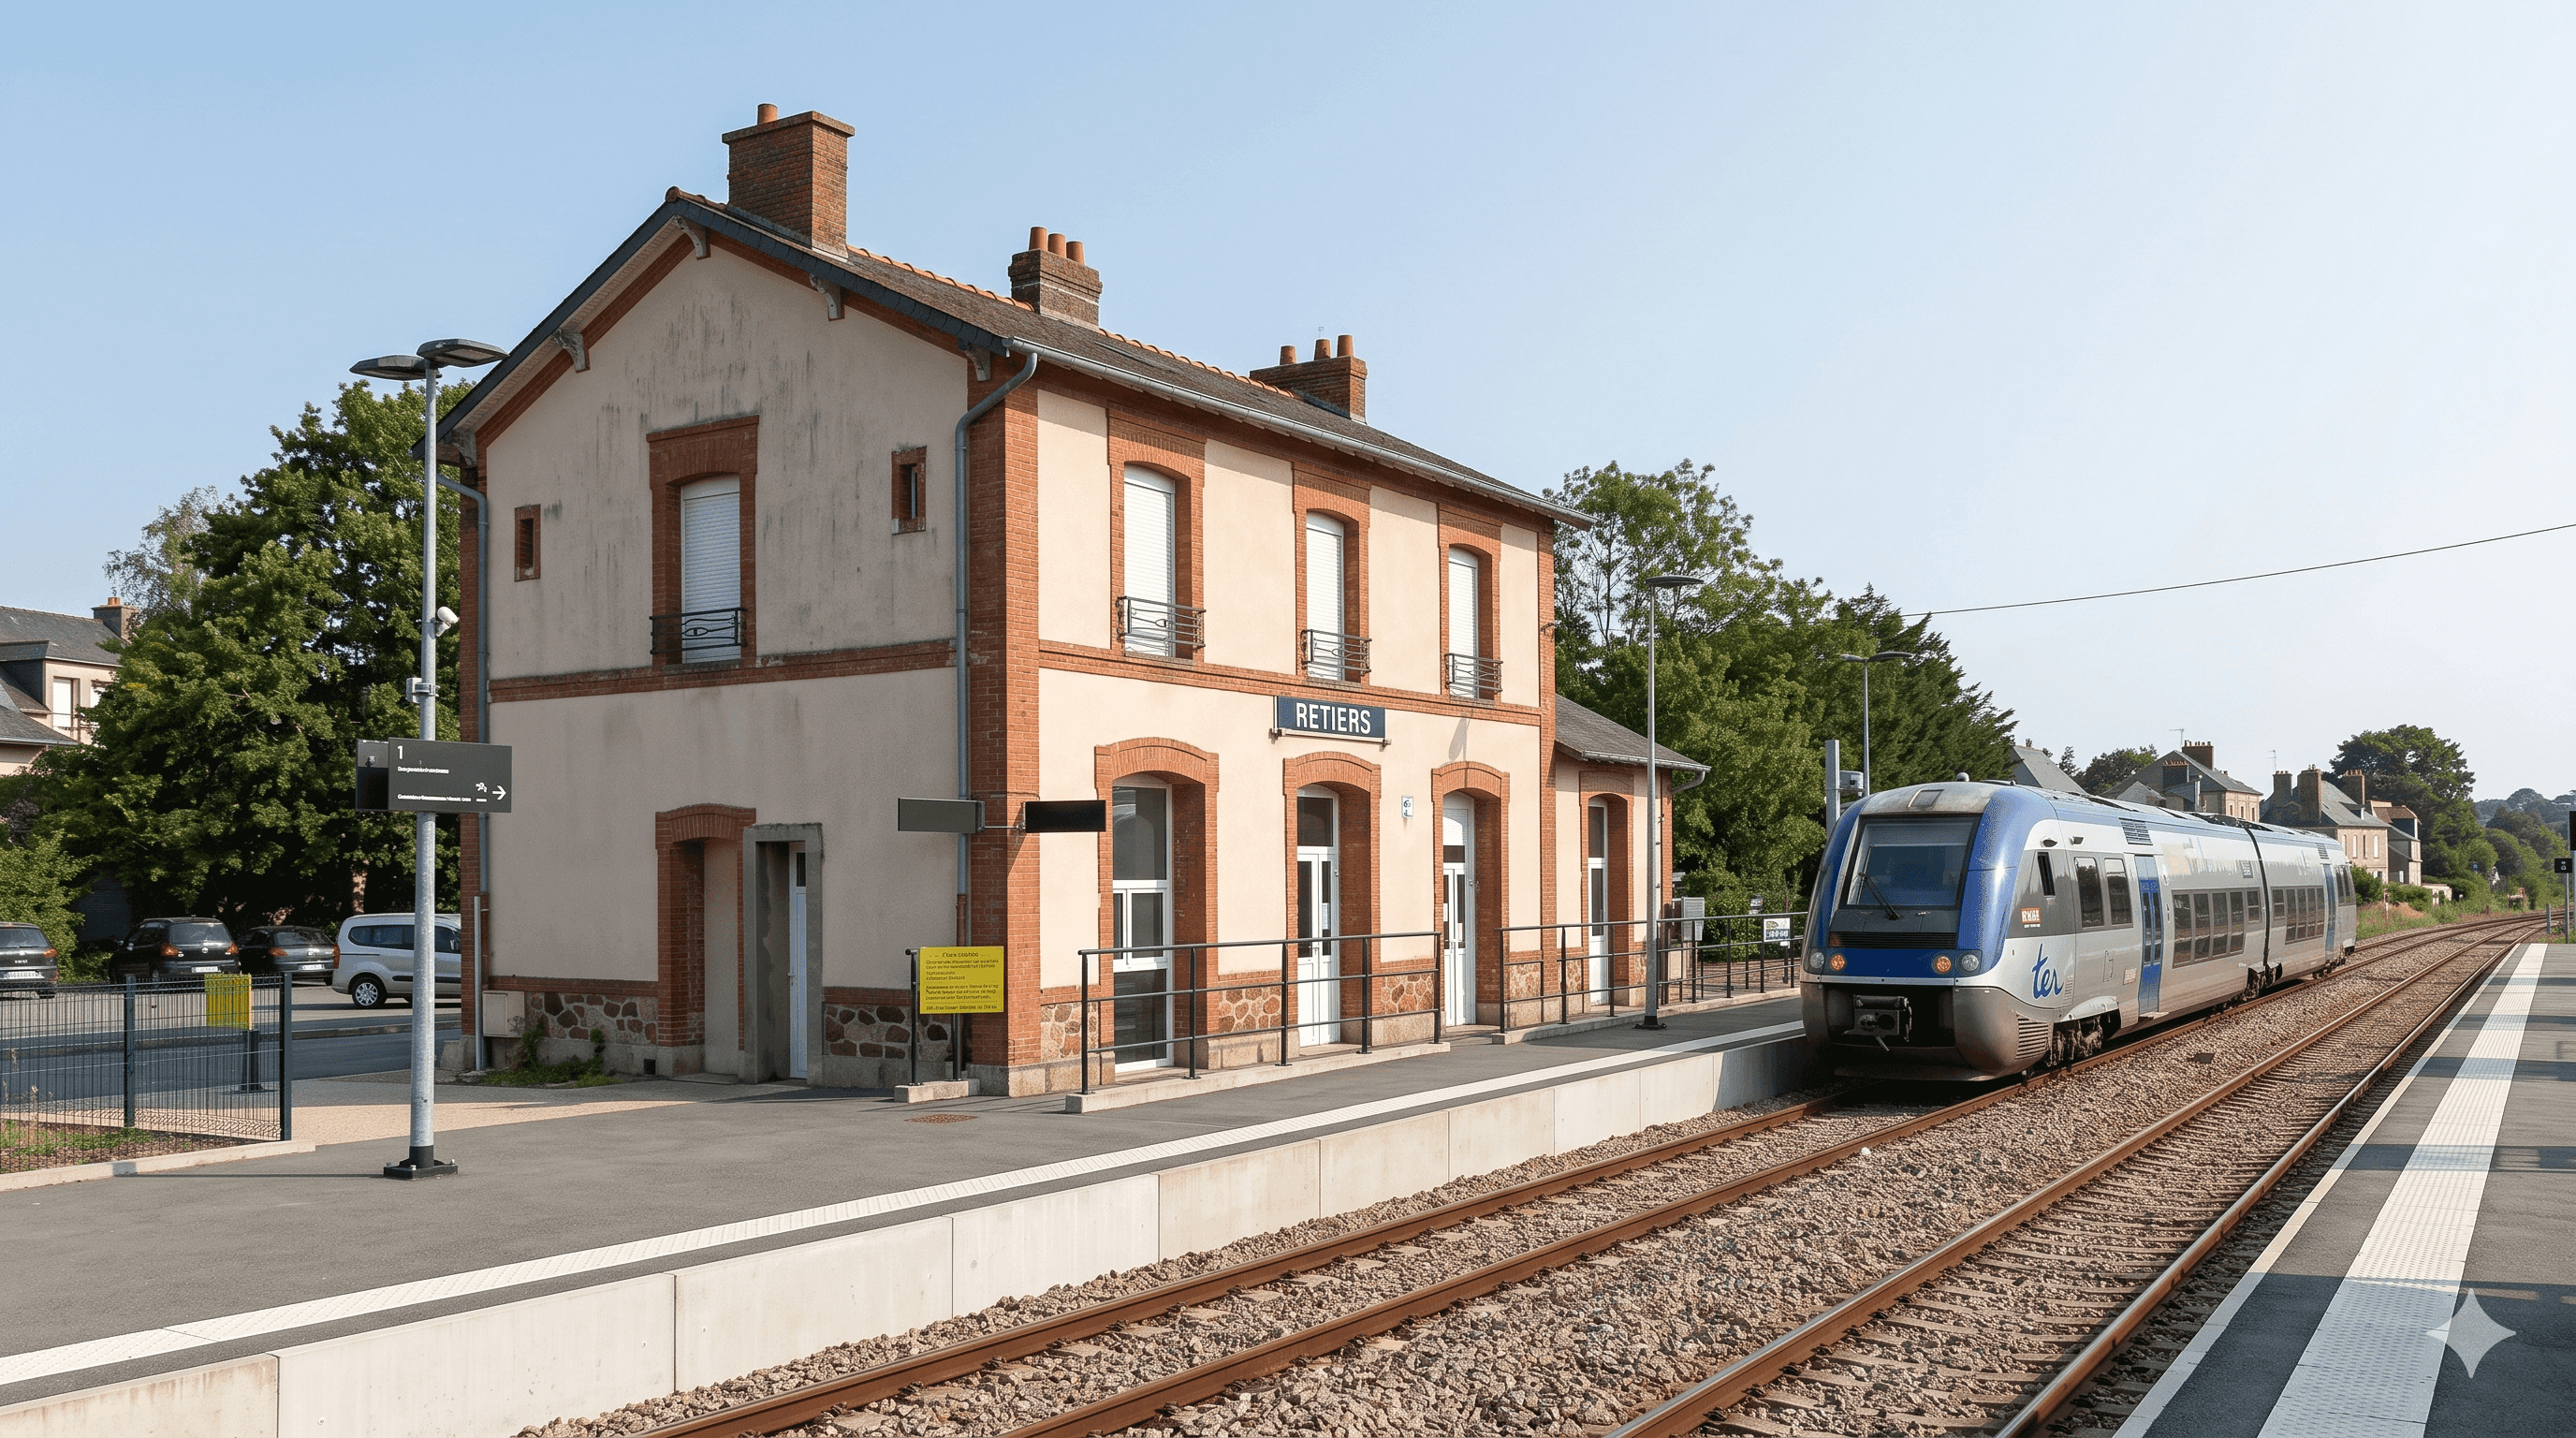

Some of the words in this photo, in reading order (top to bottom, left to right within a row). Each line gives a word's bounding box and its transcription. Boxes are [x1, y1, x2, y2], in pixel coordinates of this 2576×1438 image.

[1295, 702, 1371, 734] RETIERS
[397, 745, 403, 760] 1
[2031, 943, 2065, 999] ter
